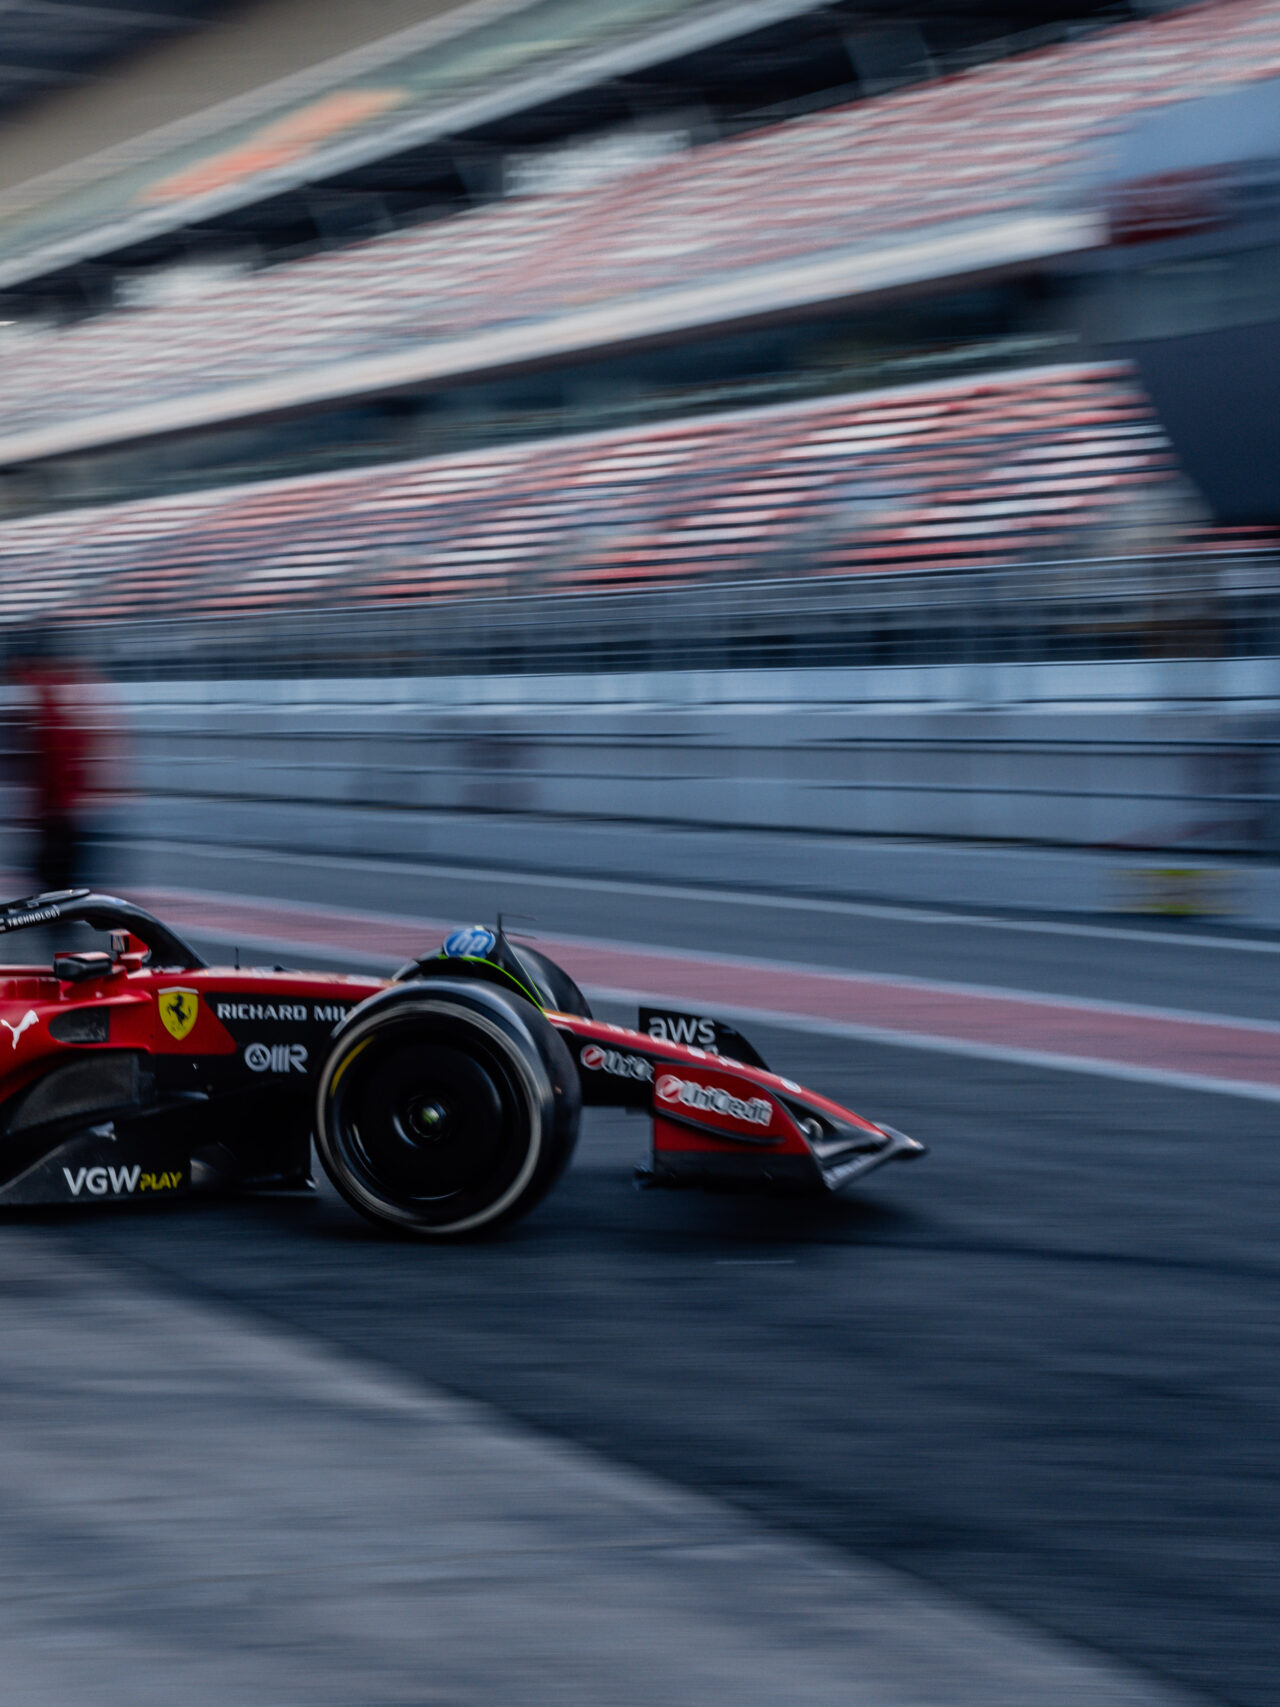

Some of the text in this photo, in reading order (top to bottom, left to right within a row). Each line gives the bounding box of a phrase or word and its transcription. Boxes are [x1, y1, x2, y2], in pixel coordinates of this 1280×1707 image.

[7, 903, 62, 928] TECHNOLOGY
[216, 1002, 308, 1022] RICHARD
[647, 1015, 716, 1044] aws
[62, 1164, 183, 1196] VGW PLAY
